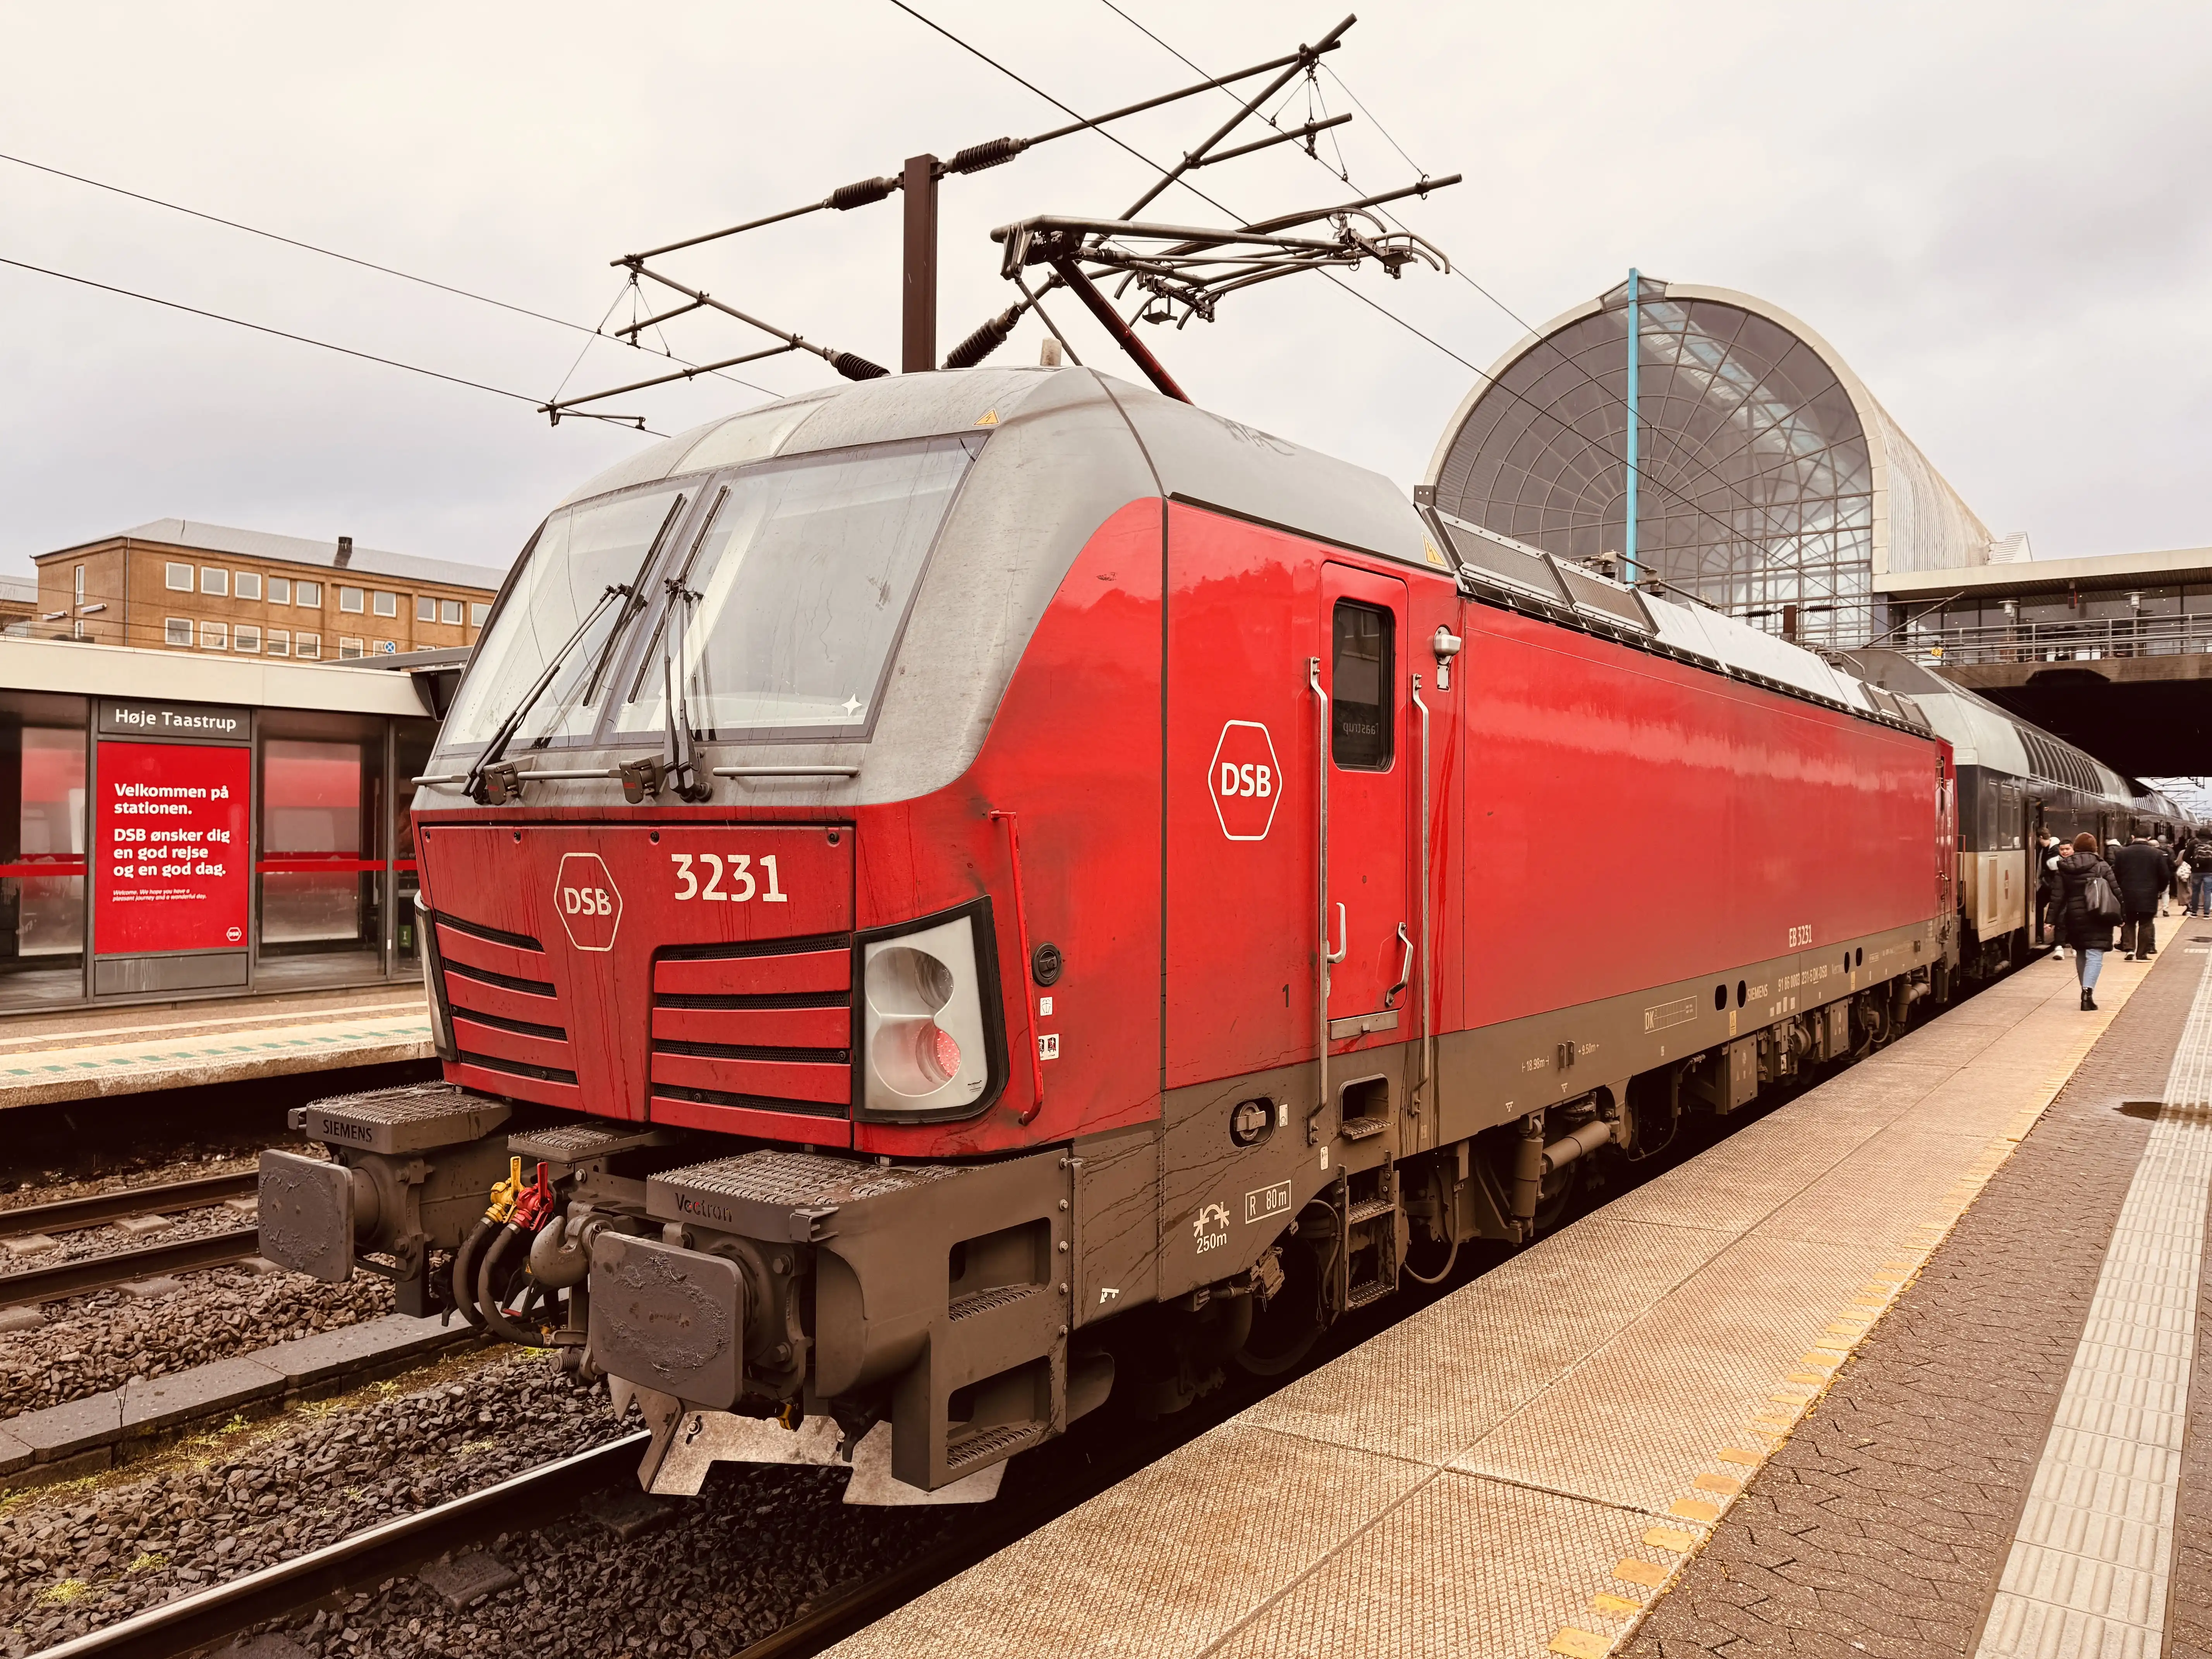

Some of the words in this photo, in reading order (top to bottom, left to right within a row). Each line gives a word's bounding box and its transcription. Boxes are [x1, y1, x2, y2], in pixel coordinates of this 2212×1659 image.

[115, 709, 156, 727] Høje
[161, 712, 236, 732] Taastrup
[1221, 762, 1271, 798] DSB
[114, 783, 206, 798] Velkommen
[211, 785, 229, 801] på
[114, 801, 192, 814] stationen.
[114, 828, 146, 842] DSB
[151, 828, 203, 842] ønsker
[207, 828, 230, 844] dig
[113, 848, 133, 859] en
[138, 845, 167, 861] god
[172, 845, 208, 861] rejse
[113, 865, 134, 878] og
[138, 865, 157, 876] en
[162, 862, 191, 878] god
[195, 862, 226, 877] dag.
[671, 854, 787, 902] 3231
[563, 887, 612, 915] DSB
[1789, 927, 1796, 948] EB
[1798, 924, 1812, 946] 3231
[1778, 978, 1783, 992] 91
[1784, 976, 1790, 990] 86
[1802, 969, 1812, 984] 231-5
[1283, 984, 1289, 1008] 1
[1747, 984, 1768, 1001] SIEMENS
[1645, 1010, 1654, 1030] DK
[1582, 1043, 1596, 1055] 9.50m
[1526, 1057, 1545, 1072] 18.98m
[323, 1119, 372, 1143] SIEMENS
[675, 1192, 732, 1223] Vectron
[1250, 1195, 1256, 1216] R
[1197, 1233, 1227, 1254] 250m
